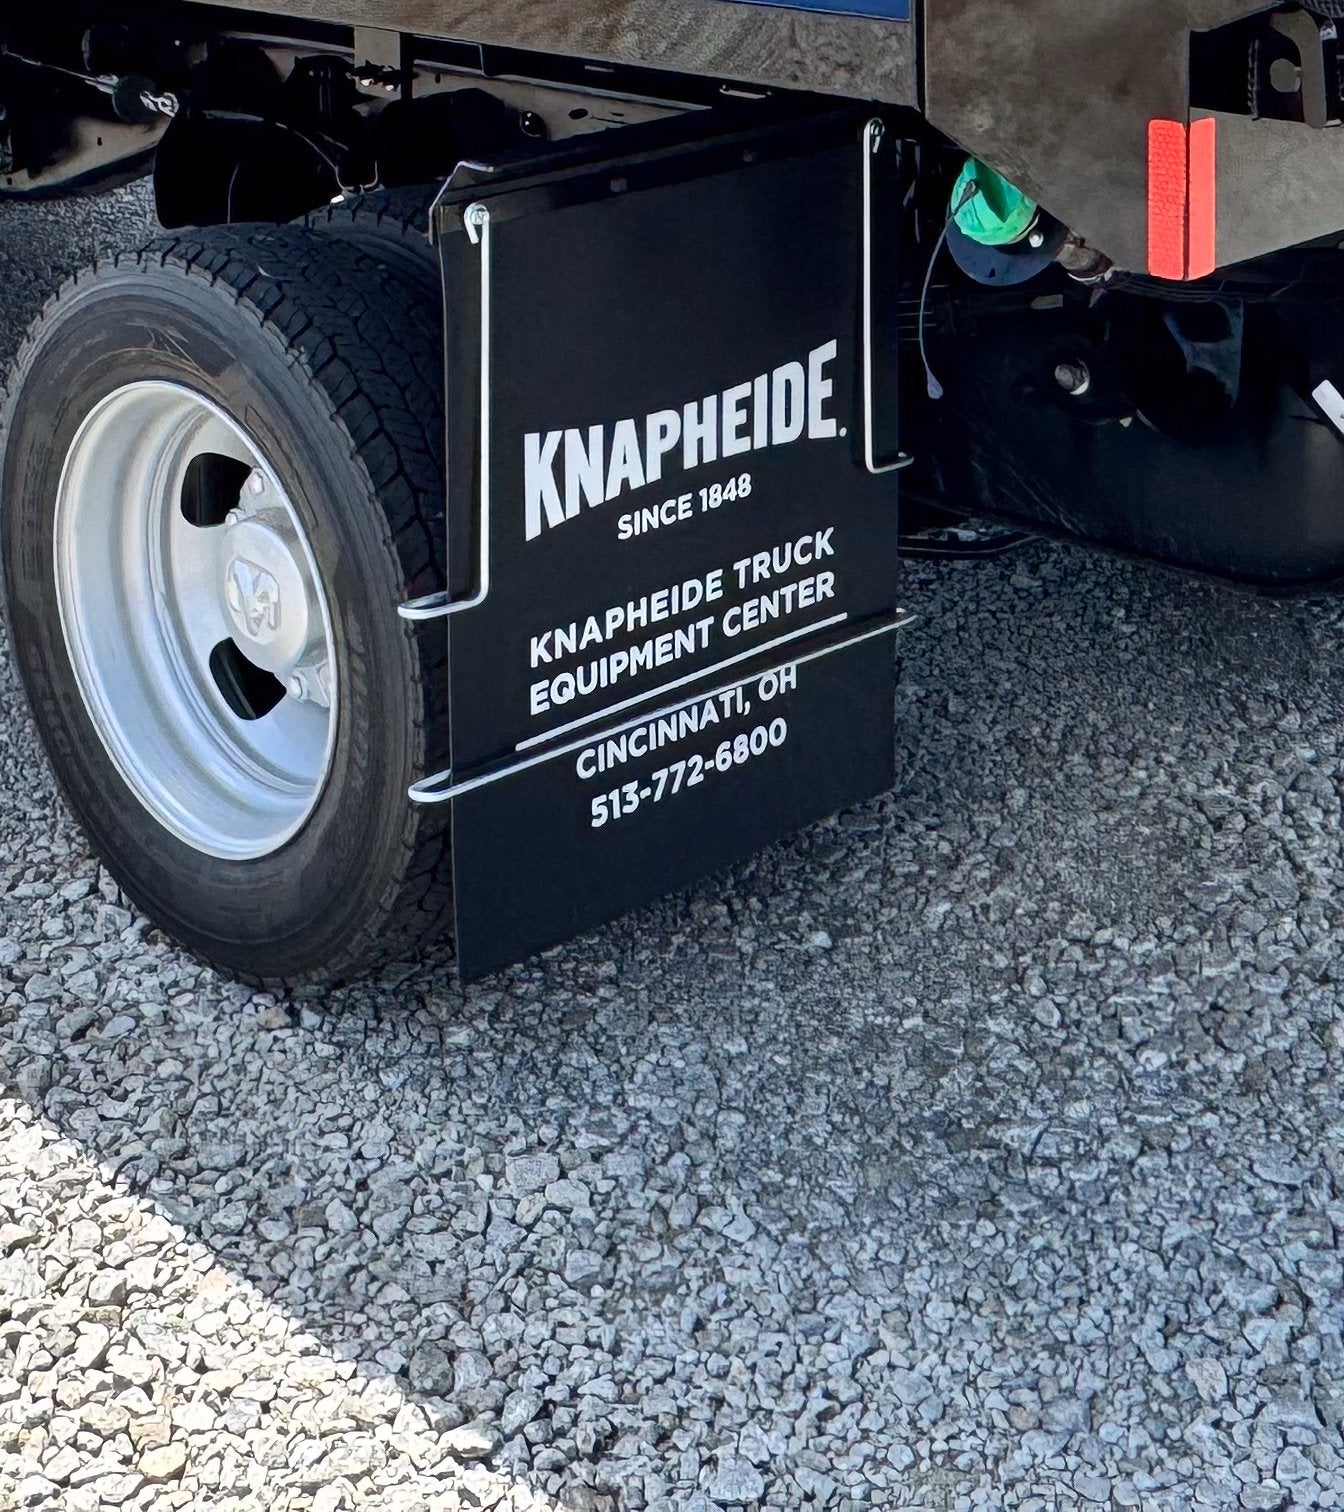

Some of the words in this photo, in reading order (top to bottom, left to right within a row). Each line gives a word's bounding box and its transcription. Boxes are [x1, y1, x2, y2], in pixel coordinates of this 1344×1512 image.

[617, 492, 693, 540] SINCE
[698, 472, 752, 513] 1848
[530, 568, 724, 669] KNAPHEIDE
[732, 526, 835, 590] TRUCK
[530, 615, 715, 716] EQUIPMENT
[722, 571, 835, 638] CENTER
[575, 686, 752, 780] CINCINNATI,
[758, 661, 798, 701] OH
[591, 717, 788, 828] 513-772-6800
